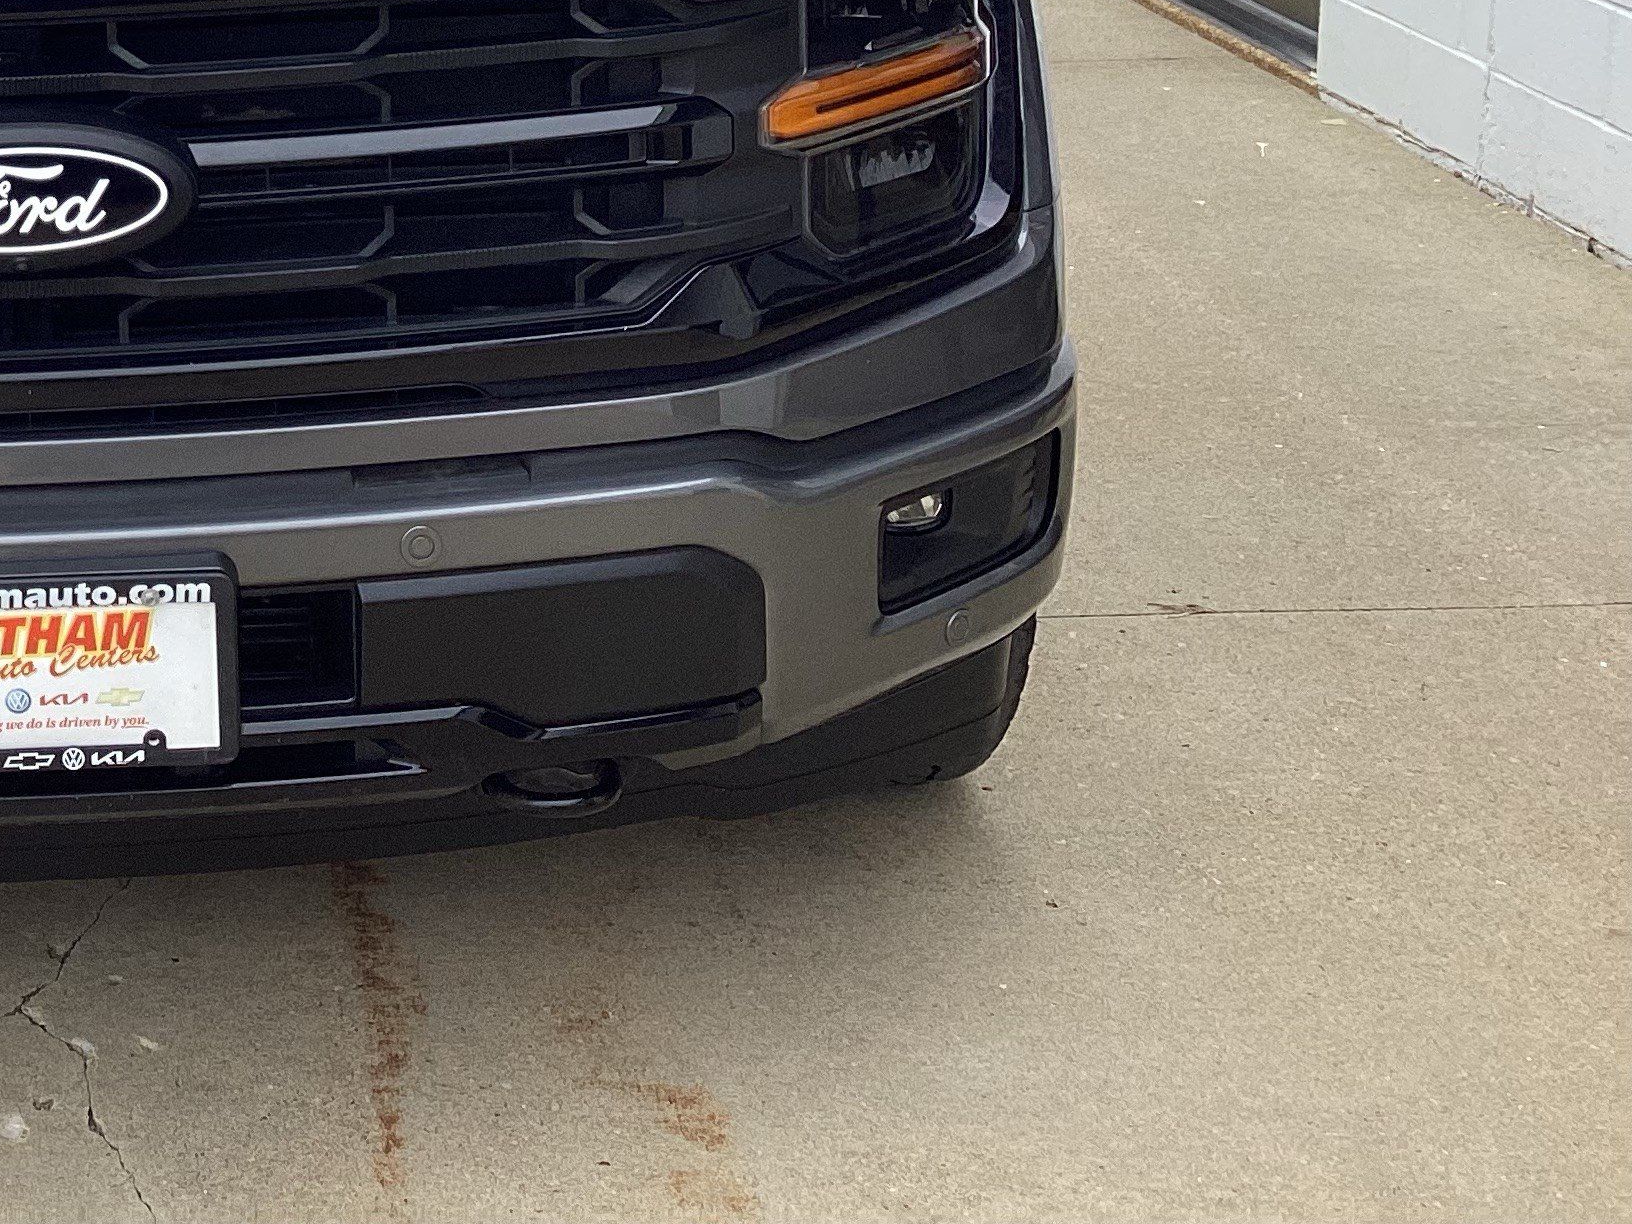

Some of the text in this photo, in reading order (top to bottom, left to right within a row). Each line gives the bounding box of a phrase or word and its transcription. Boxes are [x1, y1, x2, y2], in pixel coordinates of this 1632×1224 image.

[49, 644, 160, 677] Centers
[6, 720, 24, 729] we
[26, 718, 43, 729] do
[46, 718, 56, 728] is
[59, 717, 101, 728] driven
[105, 716, 119, 729] by
[121, 716, 149, 729] you.
